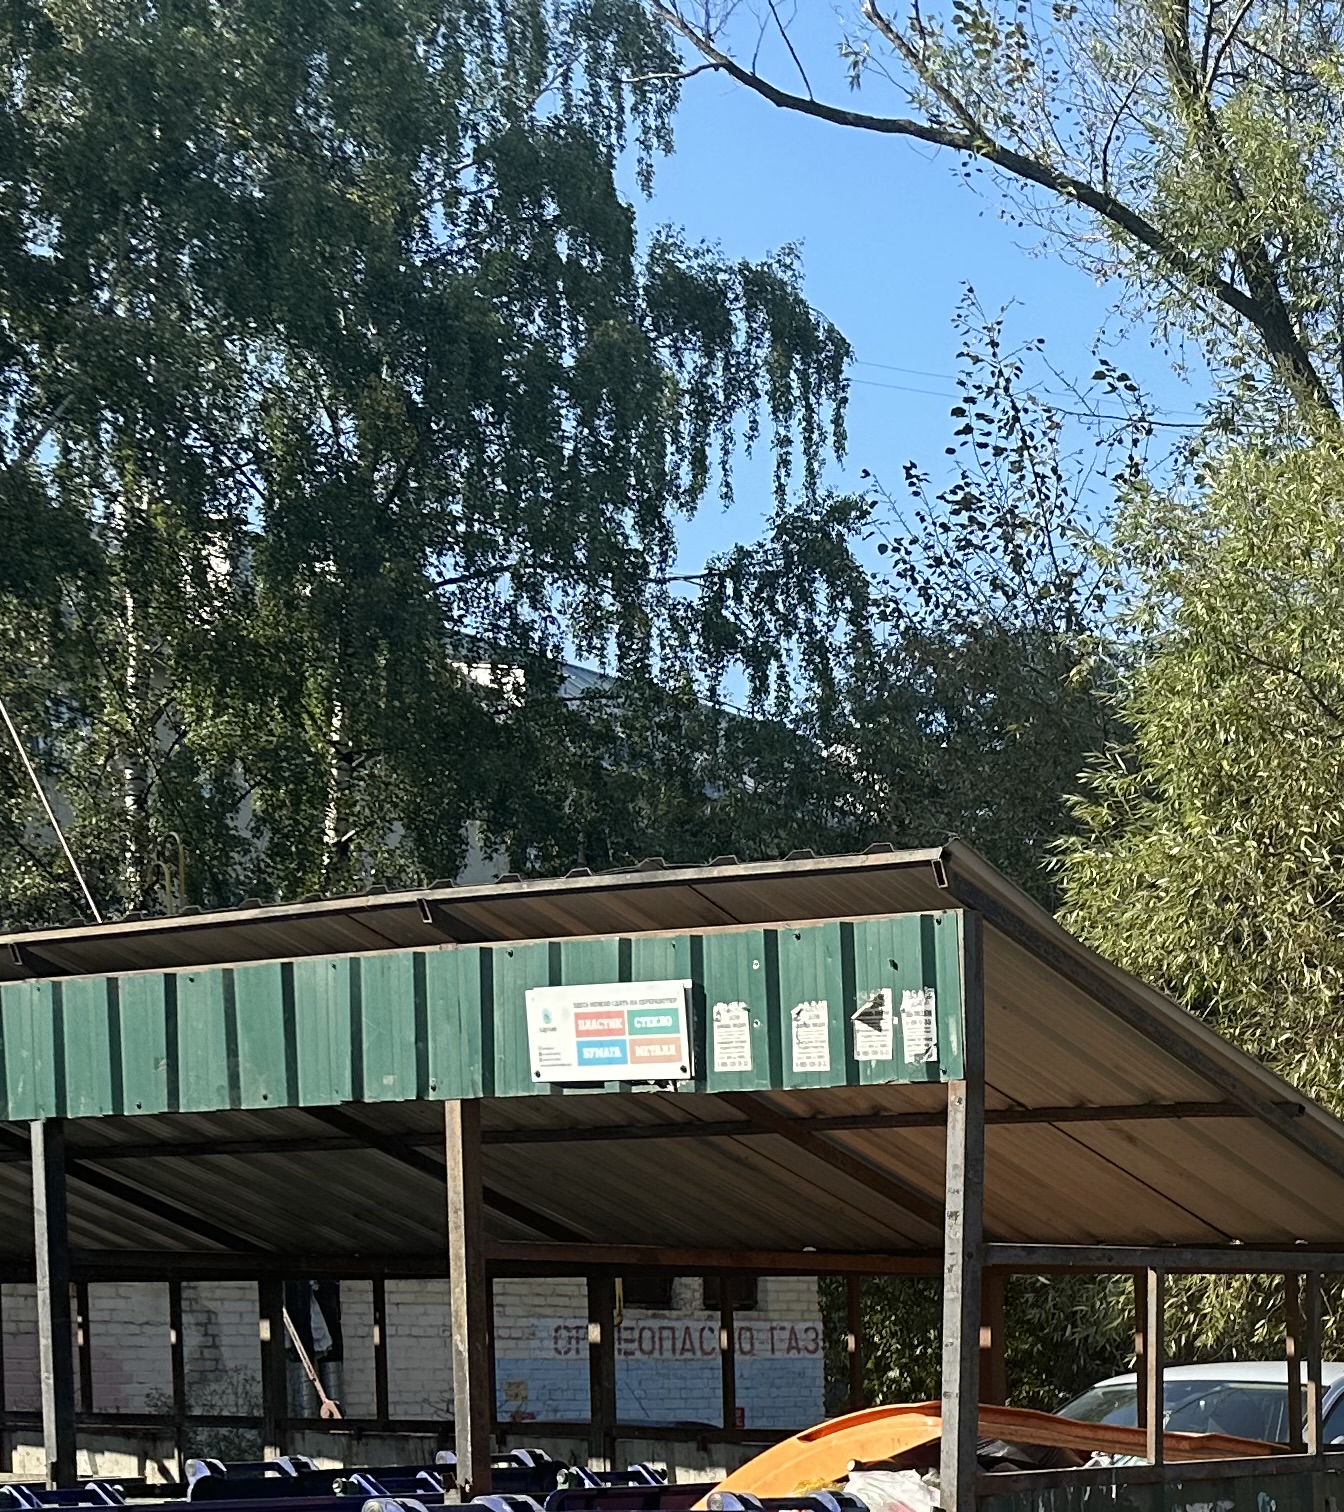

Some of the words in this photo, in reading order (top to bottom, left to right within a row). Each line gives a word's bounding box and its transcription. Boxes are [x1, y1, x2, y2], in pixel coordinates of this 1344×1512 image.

[577, 1018, 622, 1031] ПЛАСТИК
[634, 1015, 672, 1029] СТЕКЛО
[582, 1046, 622, 1059] БУМАГА
[635, 1044, 676, 1057] МЕТАЛЛ
[553, 1323, 755, 1357] ОГЕОПАСО
[770, 1324, 820, 1357] ГАЗ
